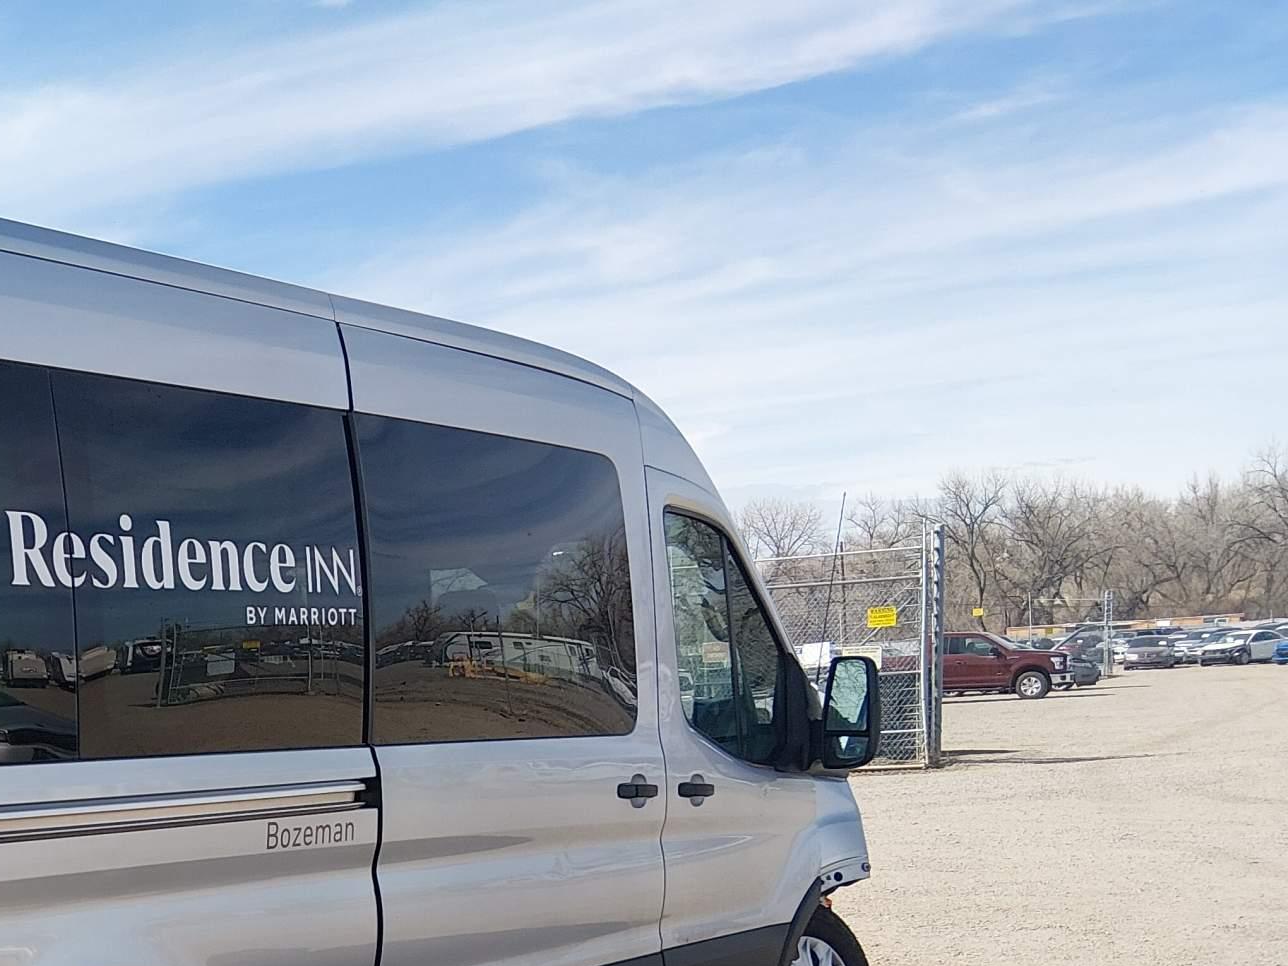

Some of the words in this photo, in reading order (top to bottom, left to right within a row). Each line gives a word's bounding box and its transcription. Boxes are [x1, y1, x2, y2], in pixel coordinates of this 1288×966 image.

[4, 509, 297, 594] Residence
[246, 606, 267, 626] BY
[274, 607, 357, 627] MARRIOTT
[266, 821, 355, 850] Bozeman
